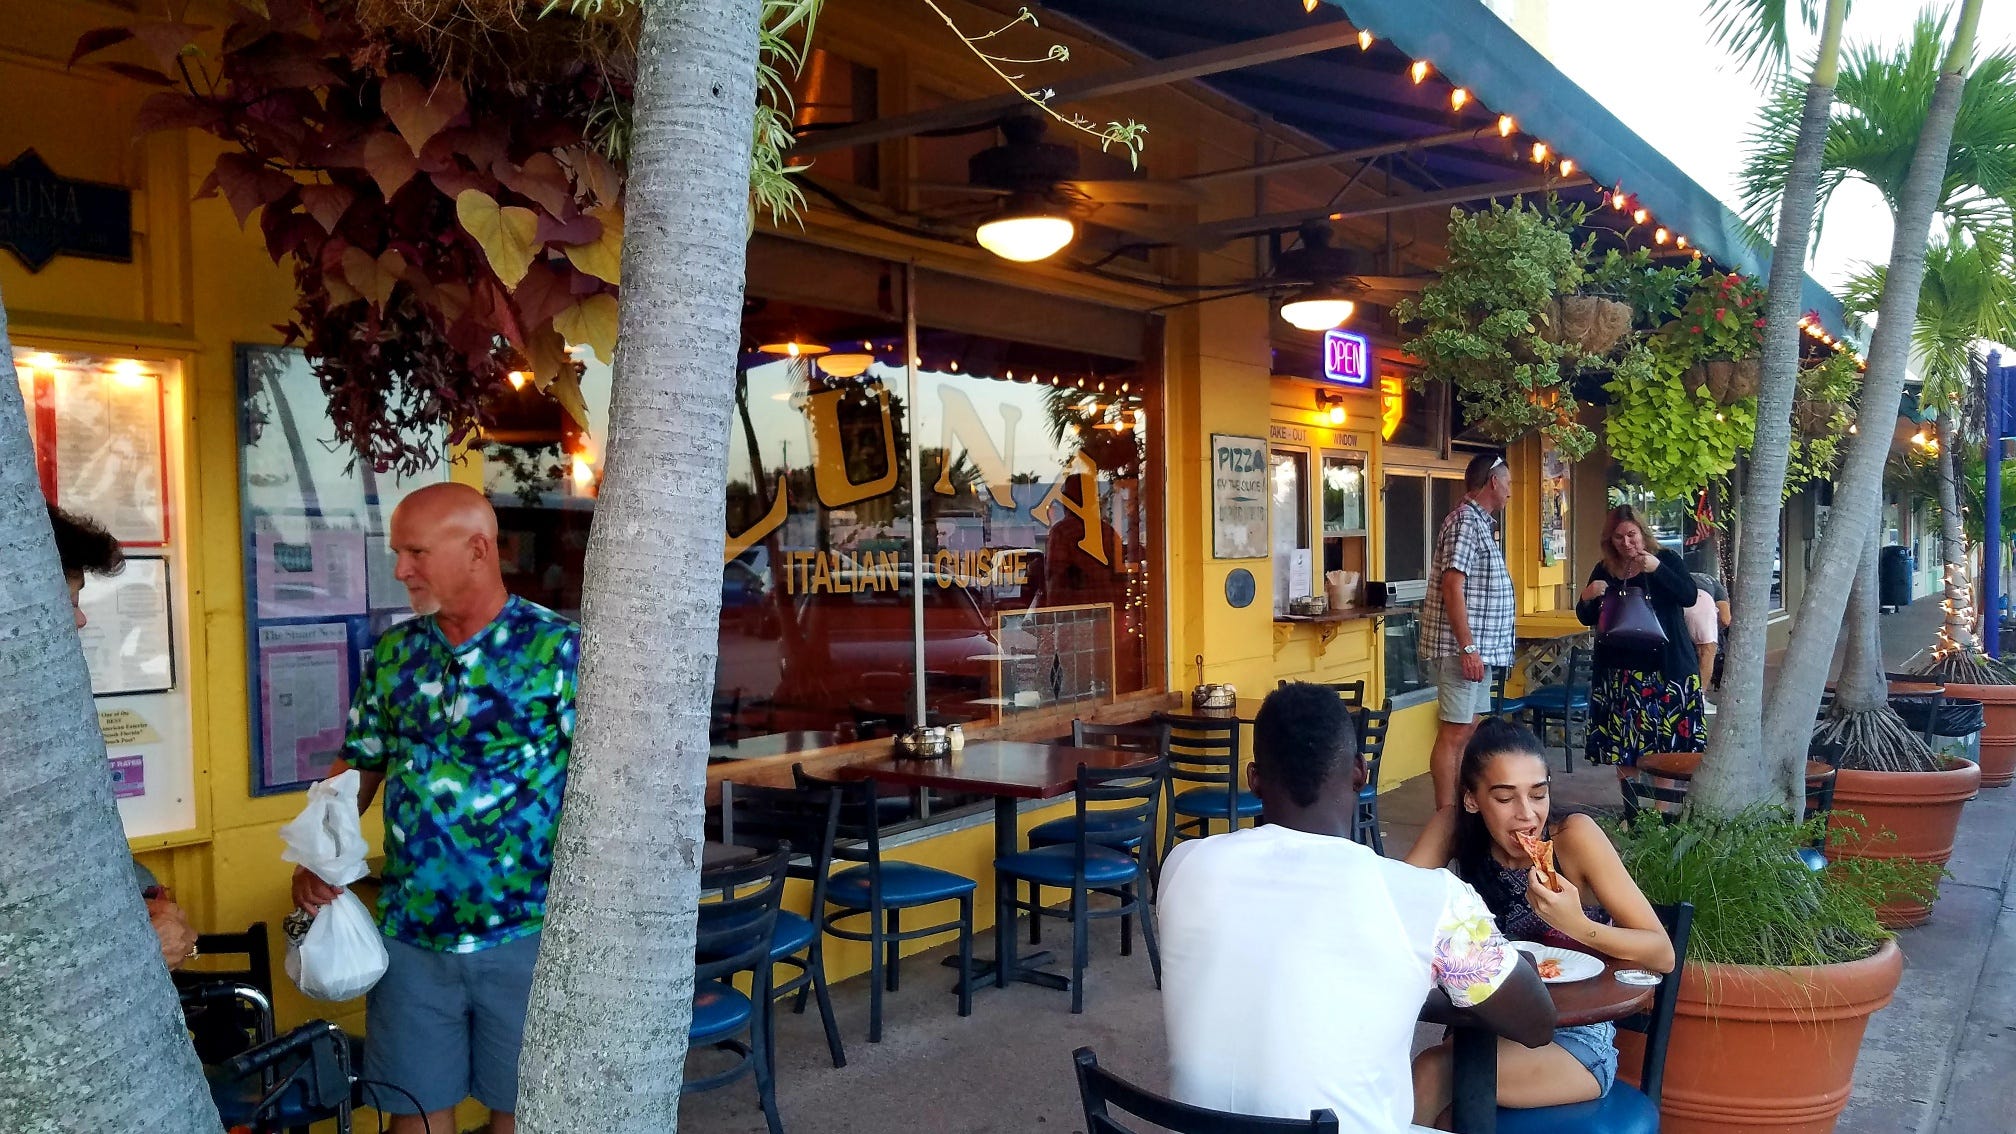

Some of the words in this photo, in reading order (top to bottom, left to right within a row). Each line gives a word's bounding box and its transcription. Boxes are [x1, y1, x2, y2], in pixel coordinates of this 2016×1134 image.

[1329, 338, 1362, 376] OPEN
[1292, 428, 1307, 441] OUT
[1333, 432, 1358, 447] WINDOW
[1217, 446, 1266, 473] PIZZA
[1228, 479, 1240, 491] THE
[786, 550, 899, 595] ITALIAN
[934, 548, 1028, 589] CUISINE
